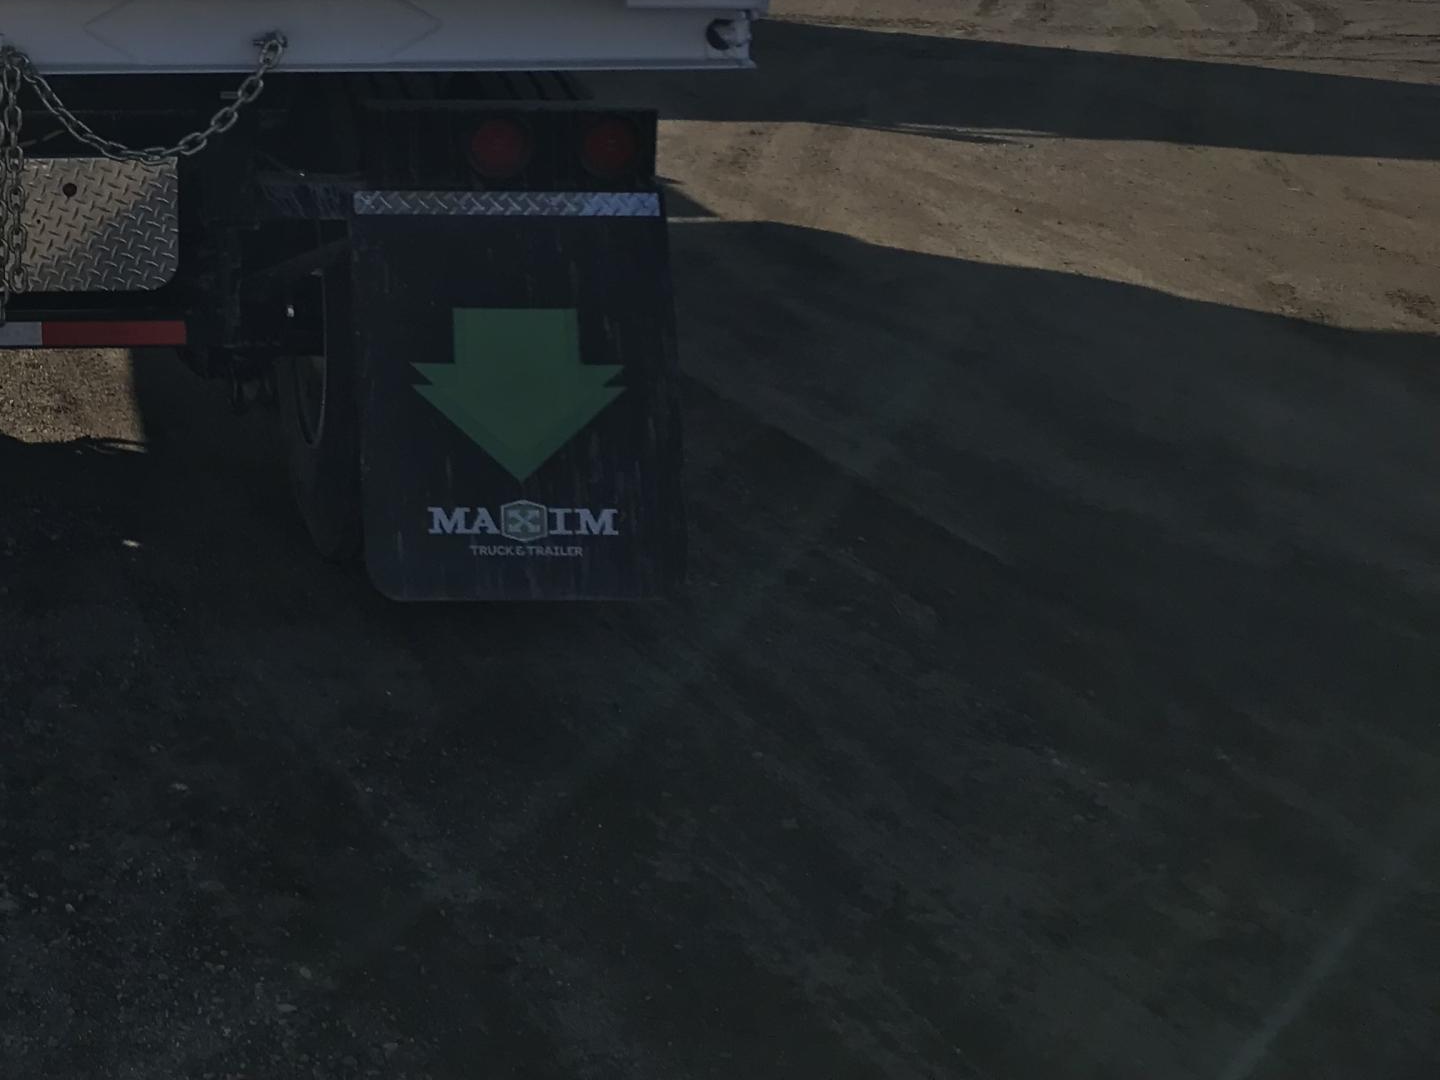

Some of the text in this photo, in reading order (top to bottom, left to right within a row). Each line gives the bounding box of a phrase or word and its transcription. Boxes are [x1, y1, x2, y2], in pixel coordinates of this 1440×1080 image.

[427, 506, 619, 536] MAXIM
[470, 545, 514, 557] TRUCK
[527, 545, 583, 557] TRAILER
